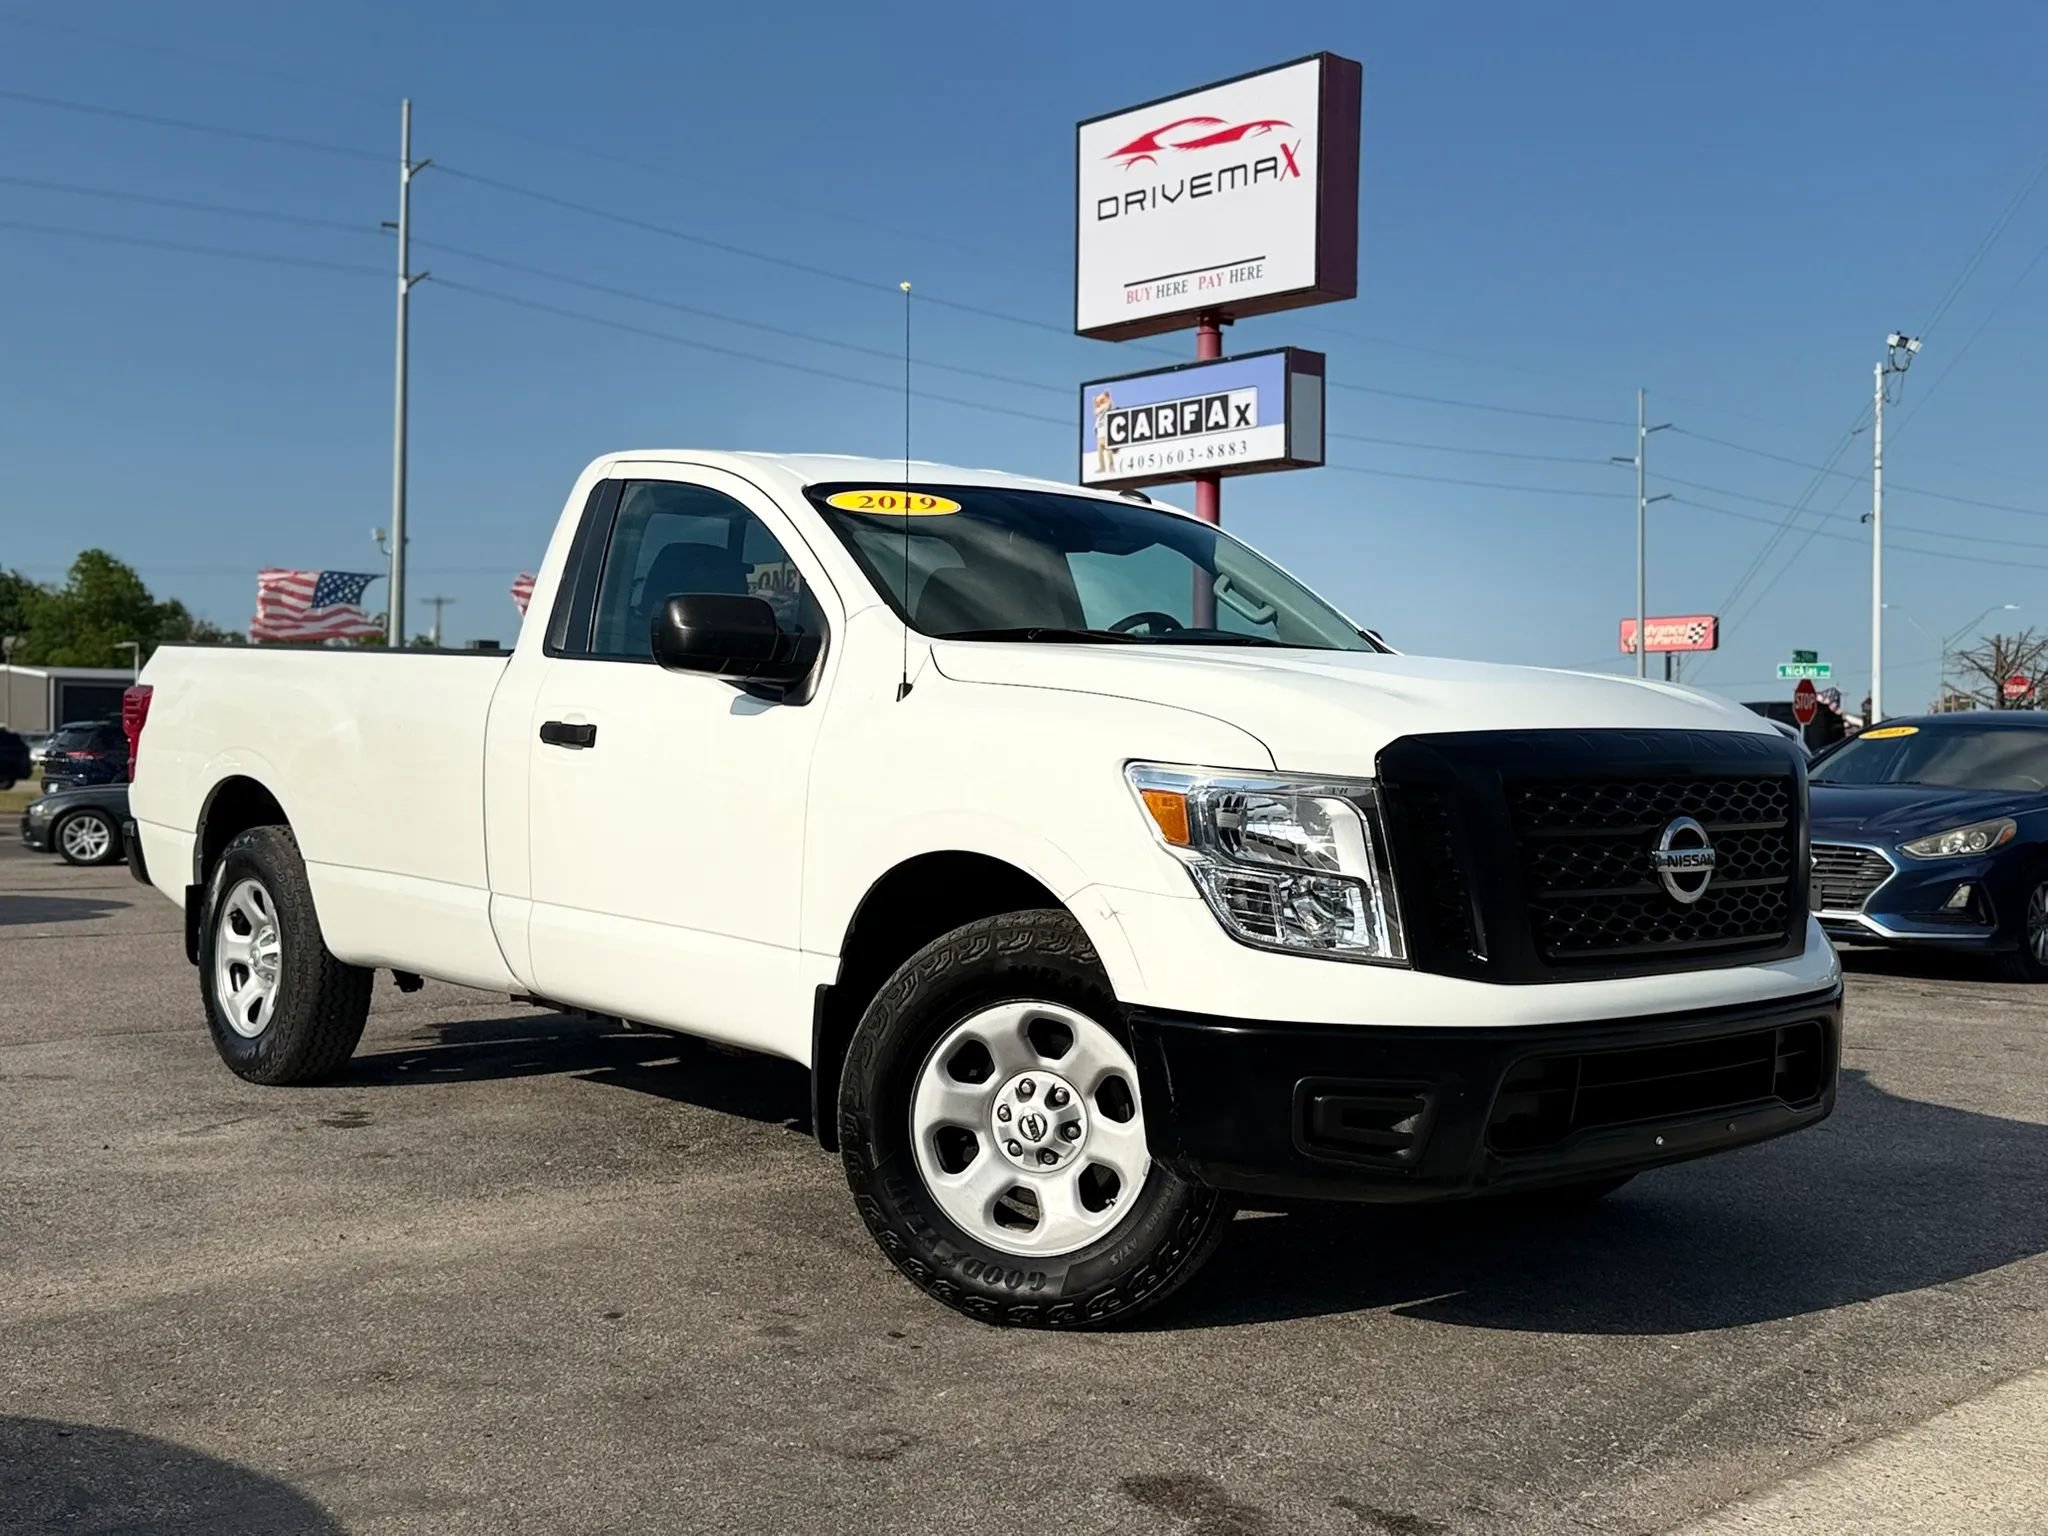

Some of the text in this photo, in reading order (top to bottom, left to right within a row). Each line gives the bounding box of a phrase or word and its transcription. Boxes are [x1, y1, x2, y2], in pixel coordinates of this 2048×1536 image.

[1126, 264, 1263, 304] BUY HERE PAY HERE
[1109, 399, 1252, 443] CARFAX
[1119, 440, 1248, 470] (405)603-8883
[857, 495, 937, 509] 2019
[1795, 692, 1816, 710] STOP
[1667, 853, 1714, 867] NISSAN
